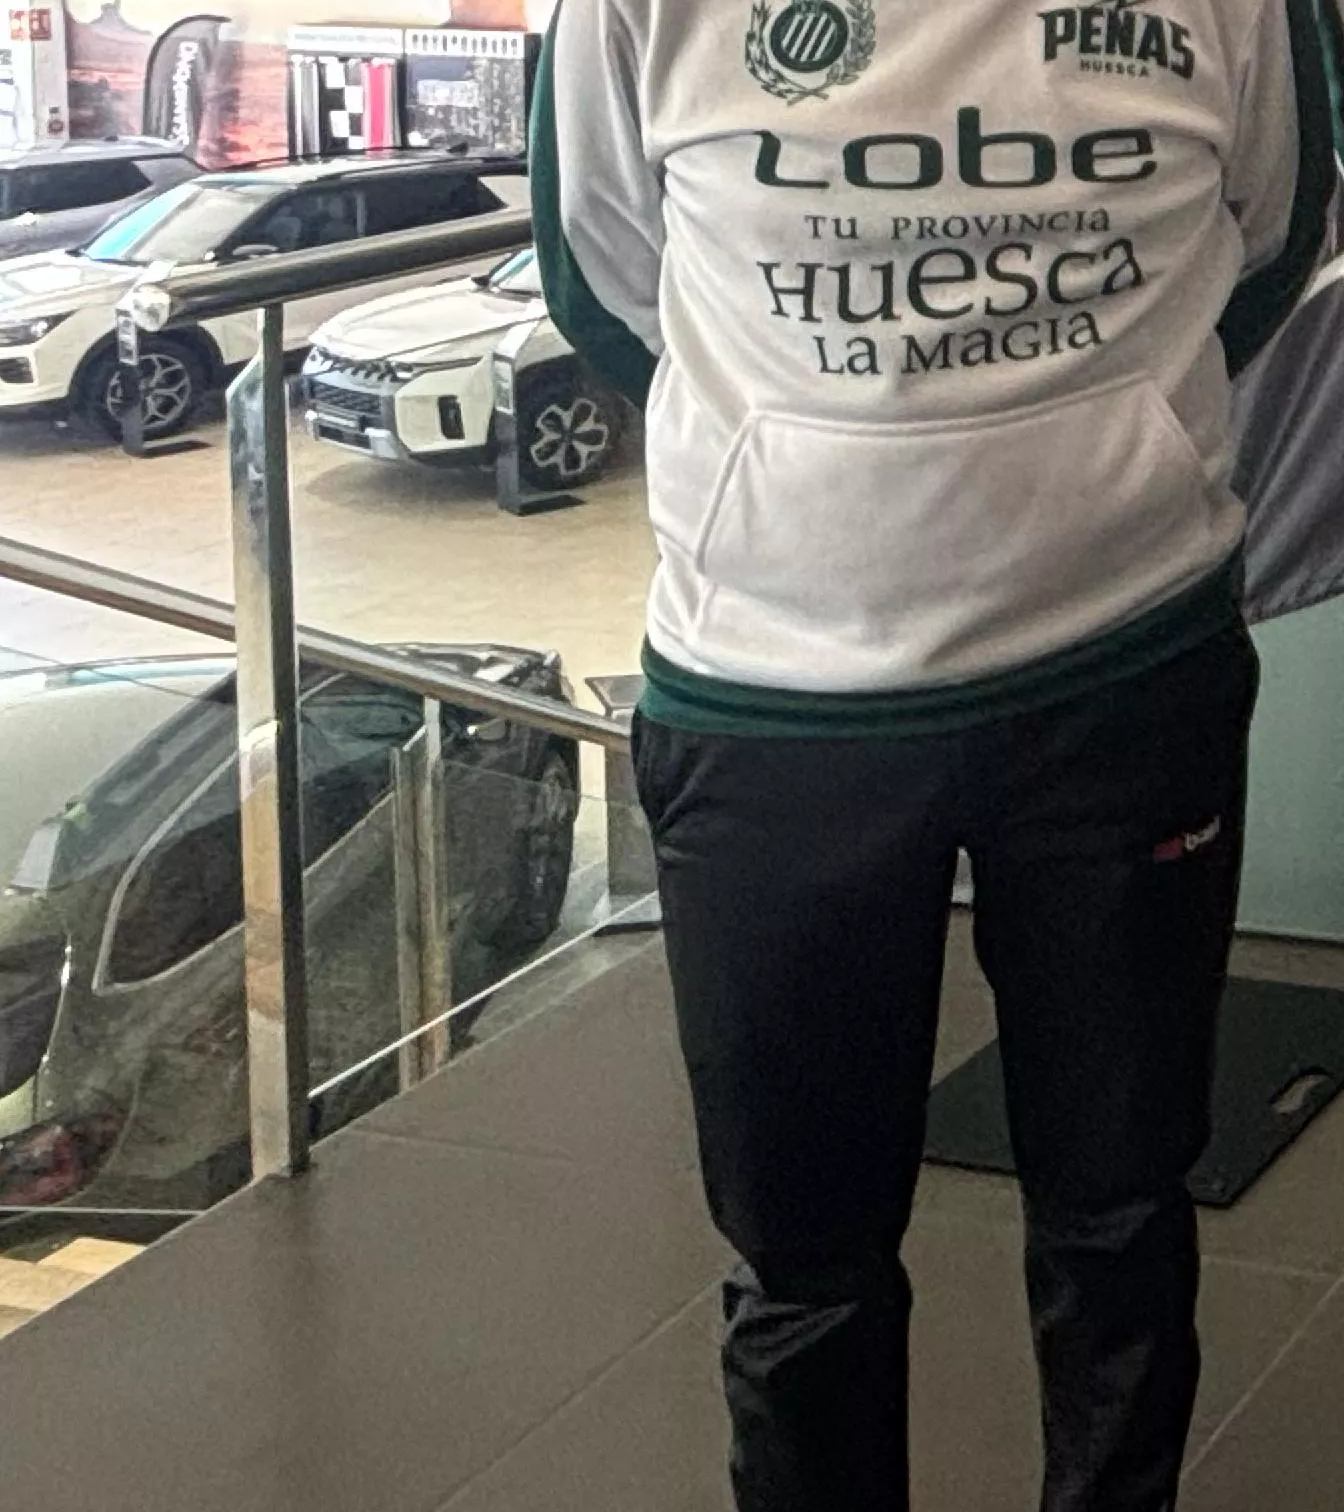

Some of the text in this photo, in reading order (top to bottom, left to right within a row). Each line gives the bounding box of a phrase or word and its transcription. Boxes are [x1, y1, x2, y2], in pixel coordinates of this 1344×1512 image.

[1079, 58, 1151, 78] HUESCA
[753, 105, 1158, 191] Lobe
[756, 236, 1146, 325] Huesca
